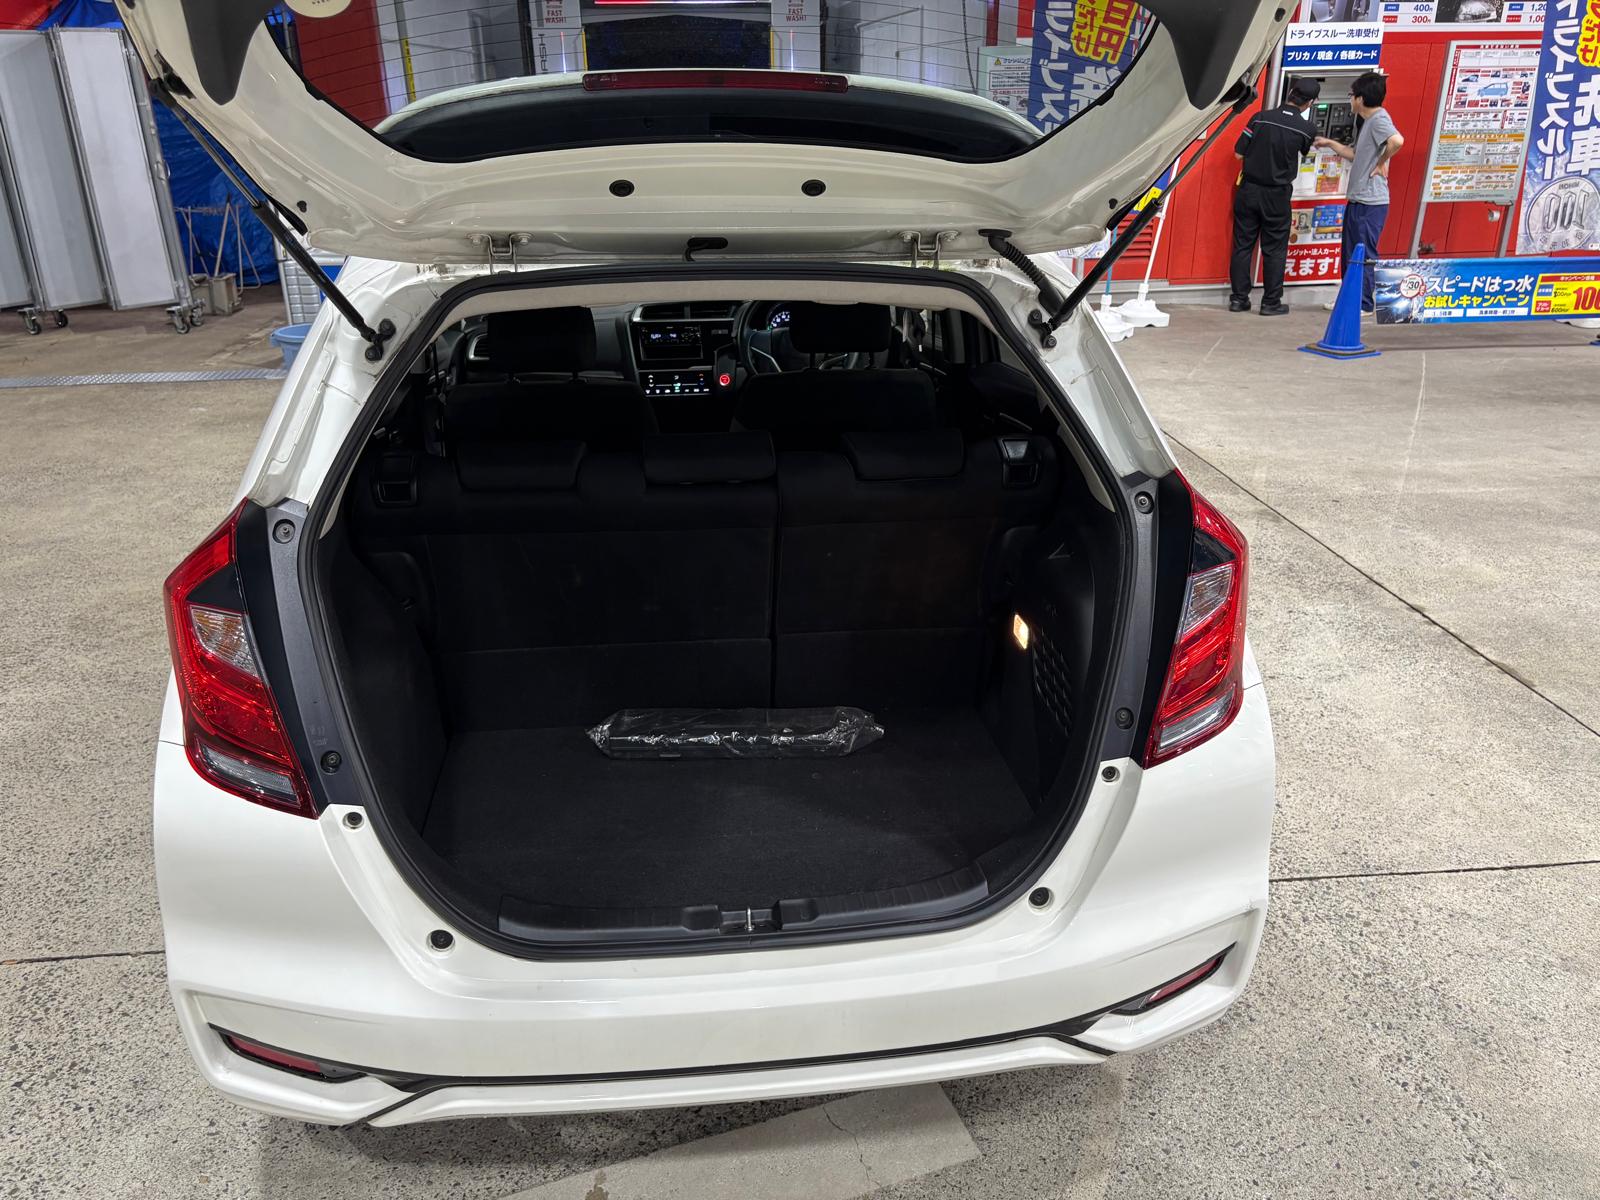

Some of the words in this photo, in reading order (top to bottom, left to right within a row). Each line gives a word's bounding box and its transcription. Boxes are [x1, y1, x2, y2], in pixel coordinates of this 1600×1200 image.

[788, 8, 803, 16] FAST
[1289, 28, 1380, 39] ドライブスルー洗車受付
[1426, 275, 1535, 293] スピードはっ水
[1423, 294, 1530, 308] お試しキャンペーン
